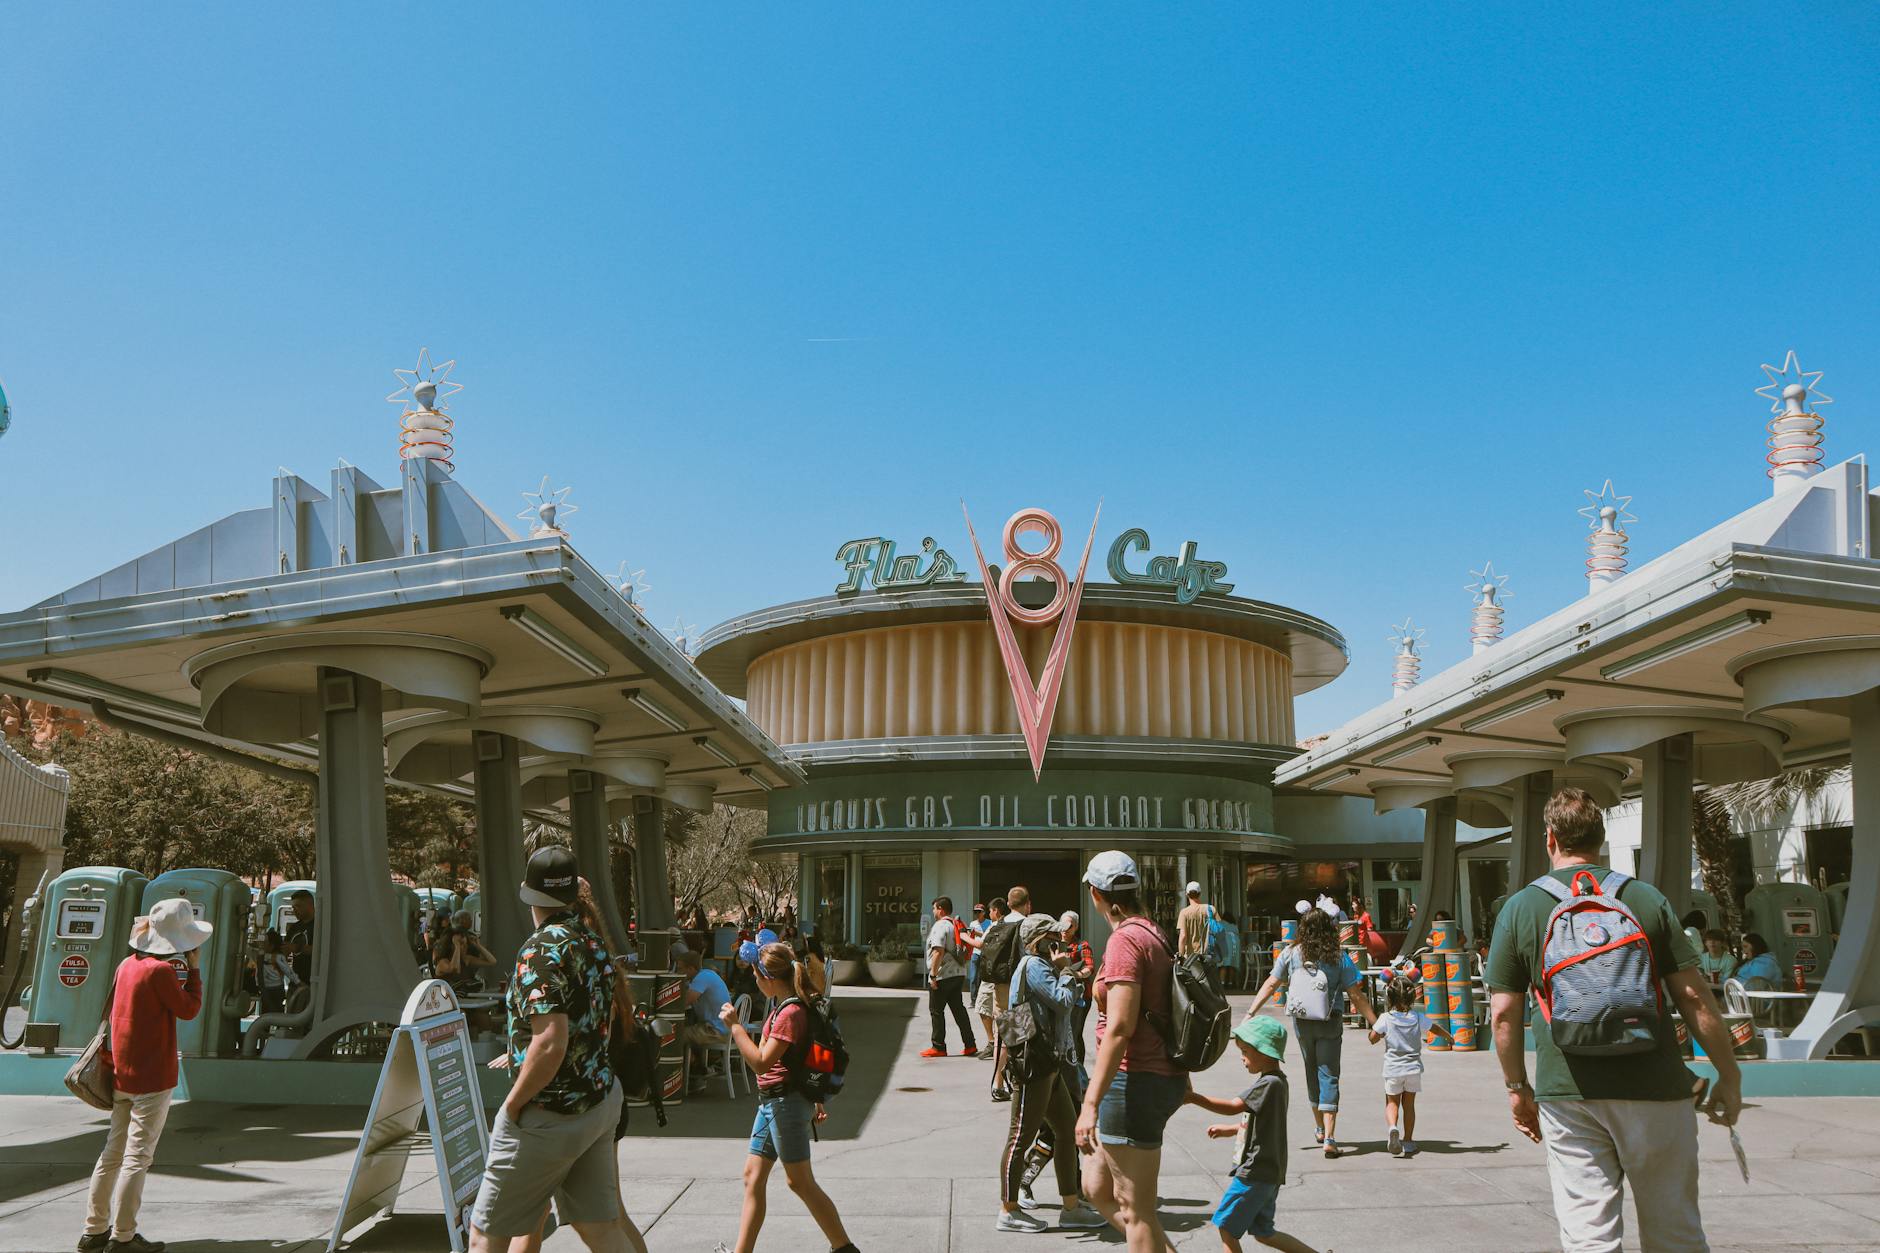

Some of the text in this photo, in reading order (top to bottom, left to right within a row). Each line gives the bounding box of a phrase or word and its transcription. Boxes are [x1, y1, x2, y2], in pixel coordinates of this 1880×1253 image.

[835, 536, 968, 593] Flo's
[797, 798, 887, 832] LUGNUTS
[906, 796, 952, 828] GAS
[980, 795, 1022, 828] OIL
[1048, 795, 1163, 829] COOLANT
[878, 886, 904, 897] DIP
[866, 902, 918, 913] STICKS
[66, 976, 79, 984] TEA
